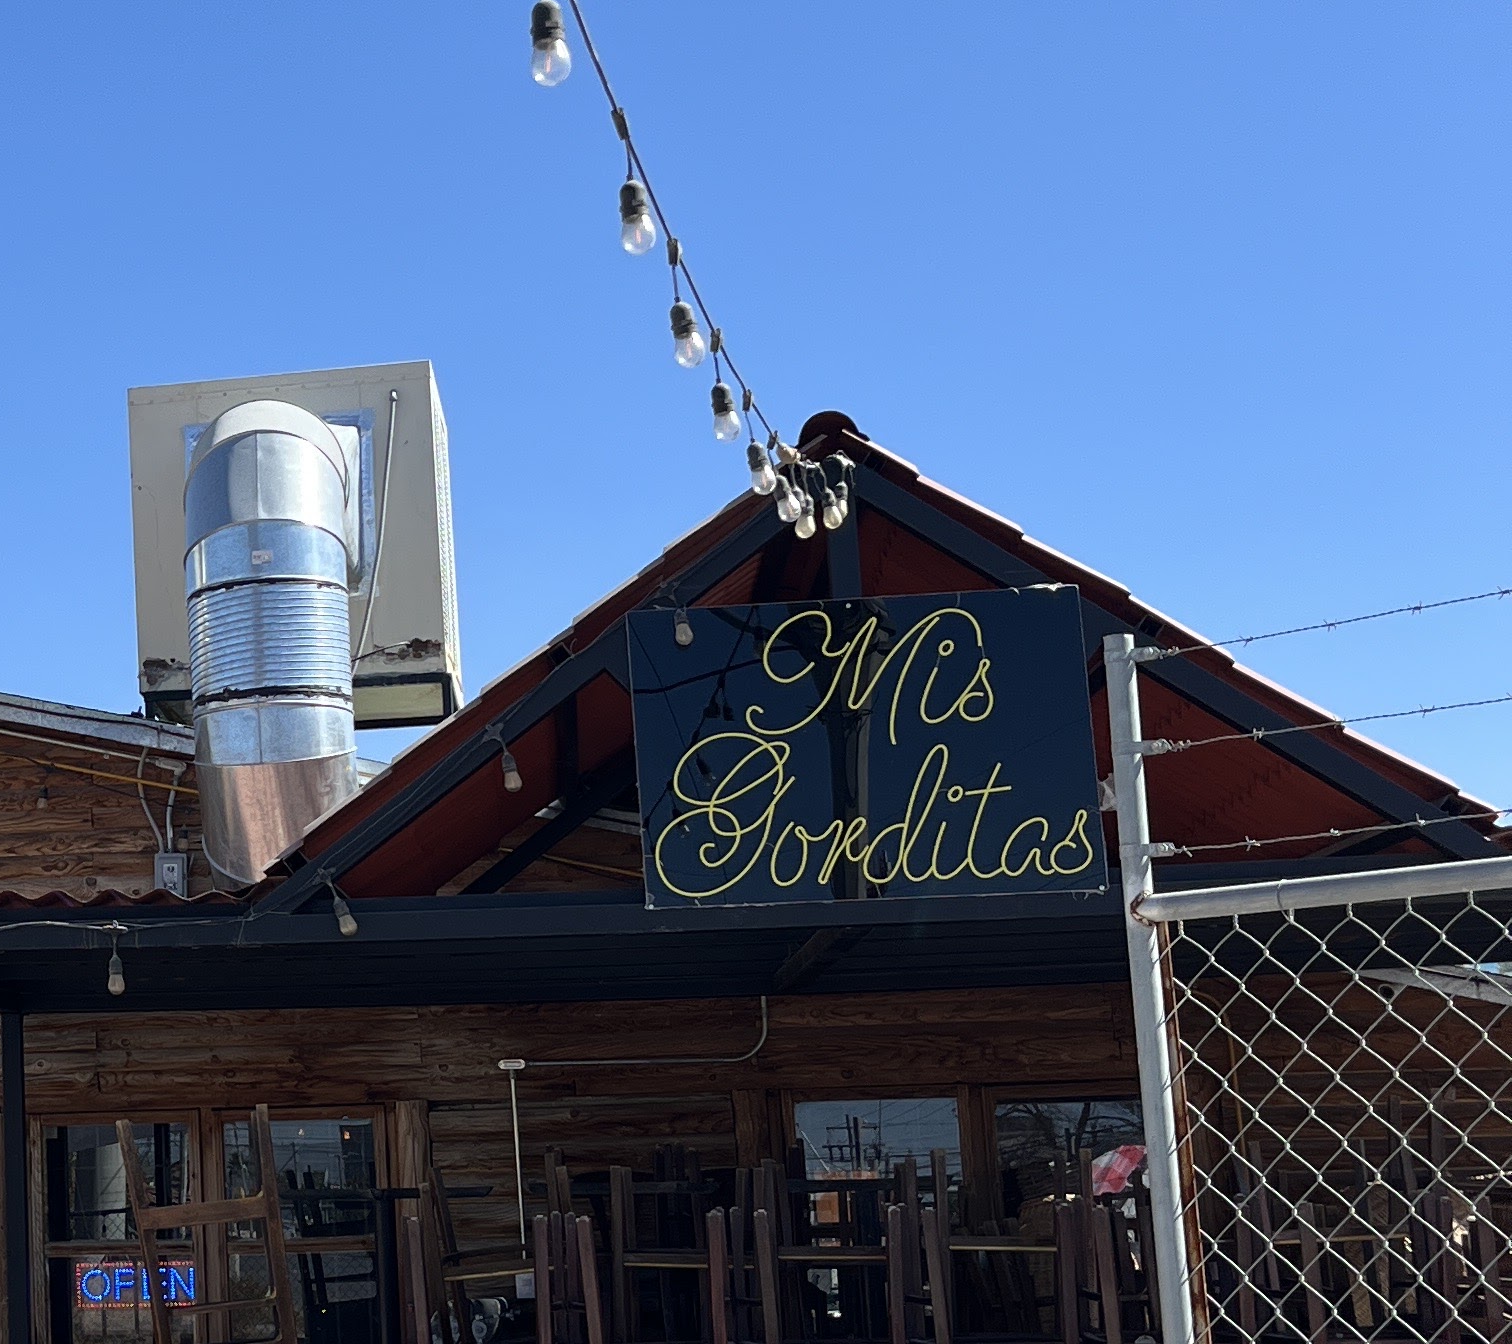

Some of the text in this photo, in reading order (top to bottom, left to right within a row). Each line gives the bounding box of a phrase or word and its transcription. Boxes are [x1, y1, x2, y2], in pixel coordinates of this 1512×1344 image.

[746, 608, 994, 745] Mis
[655, 732, 1093, 898] Gorditas
[81, 1267, 196, 1302] OPEN
